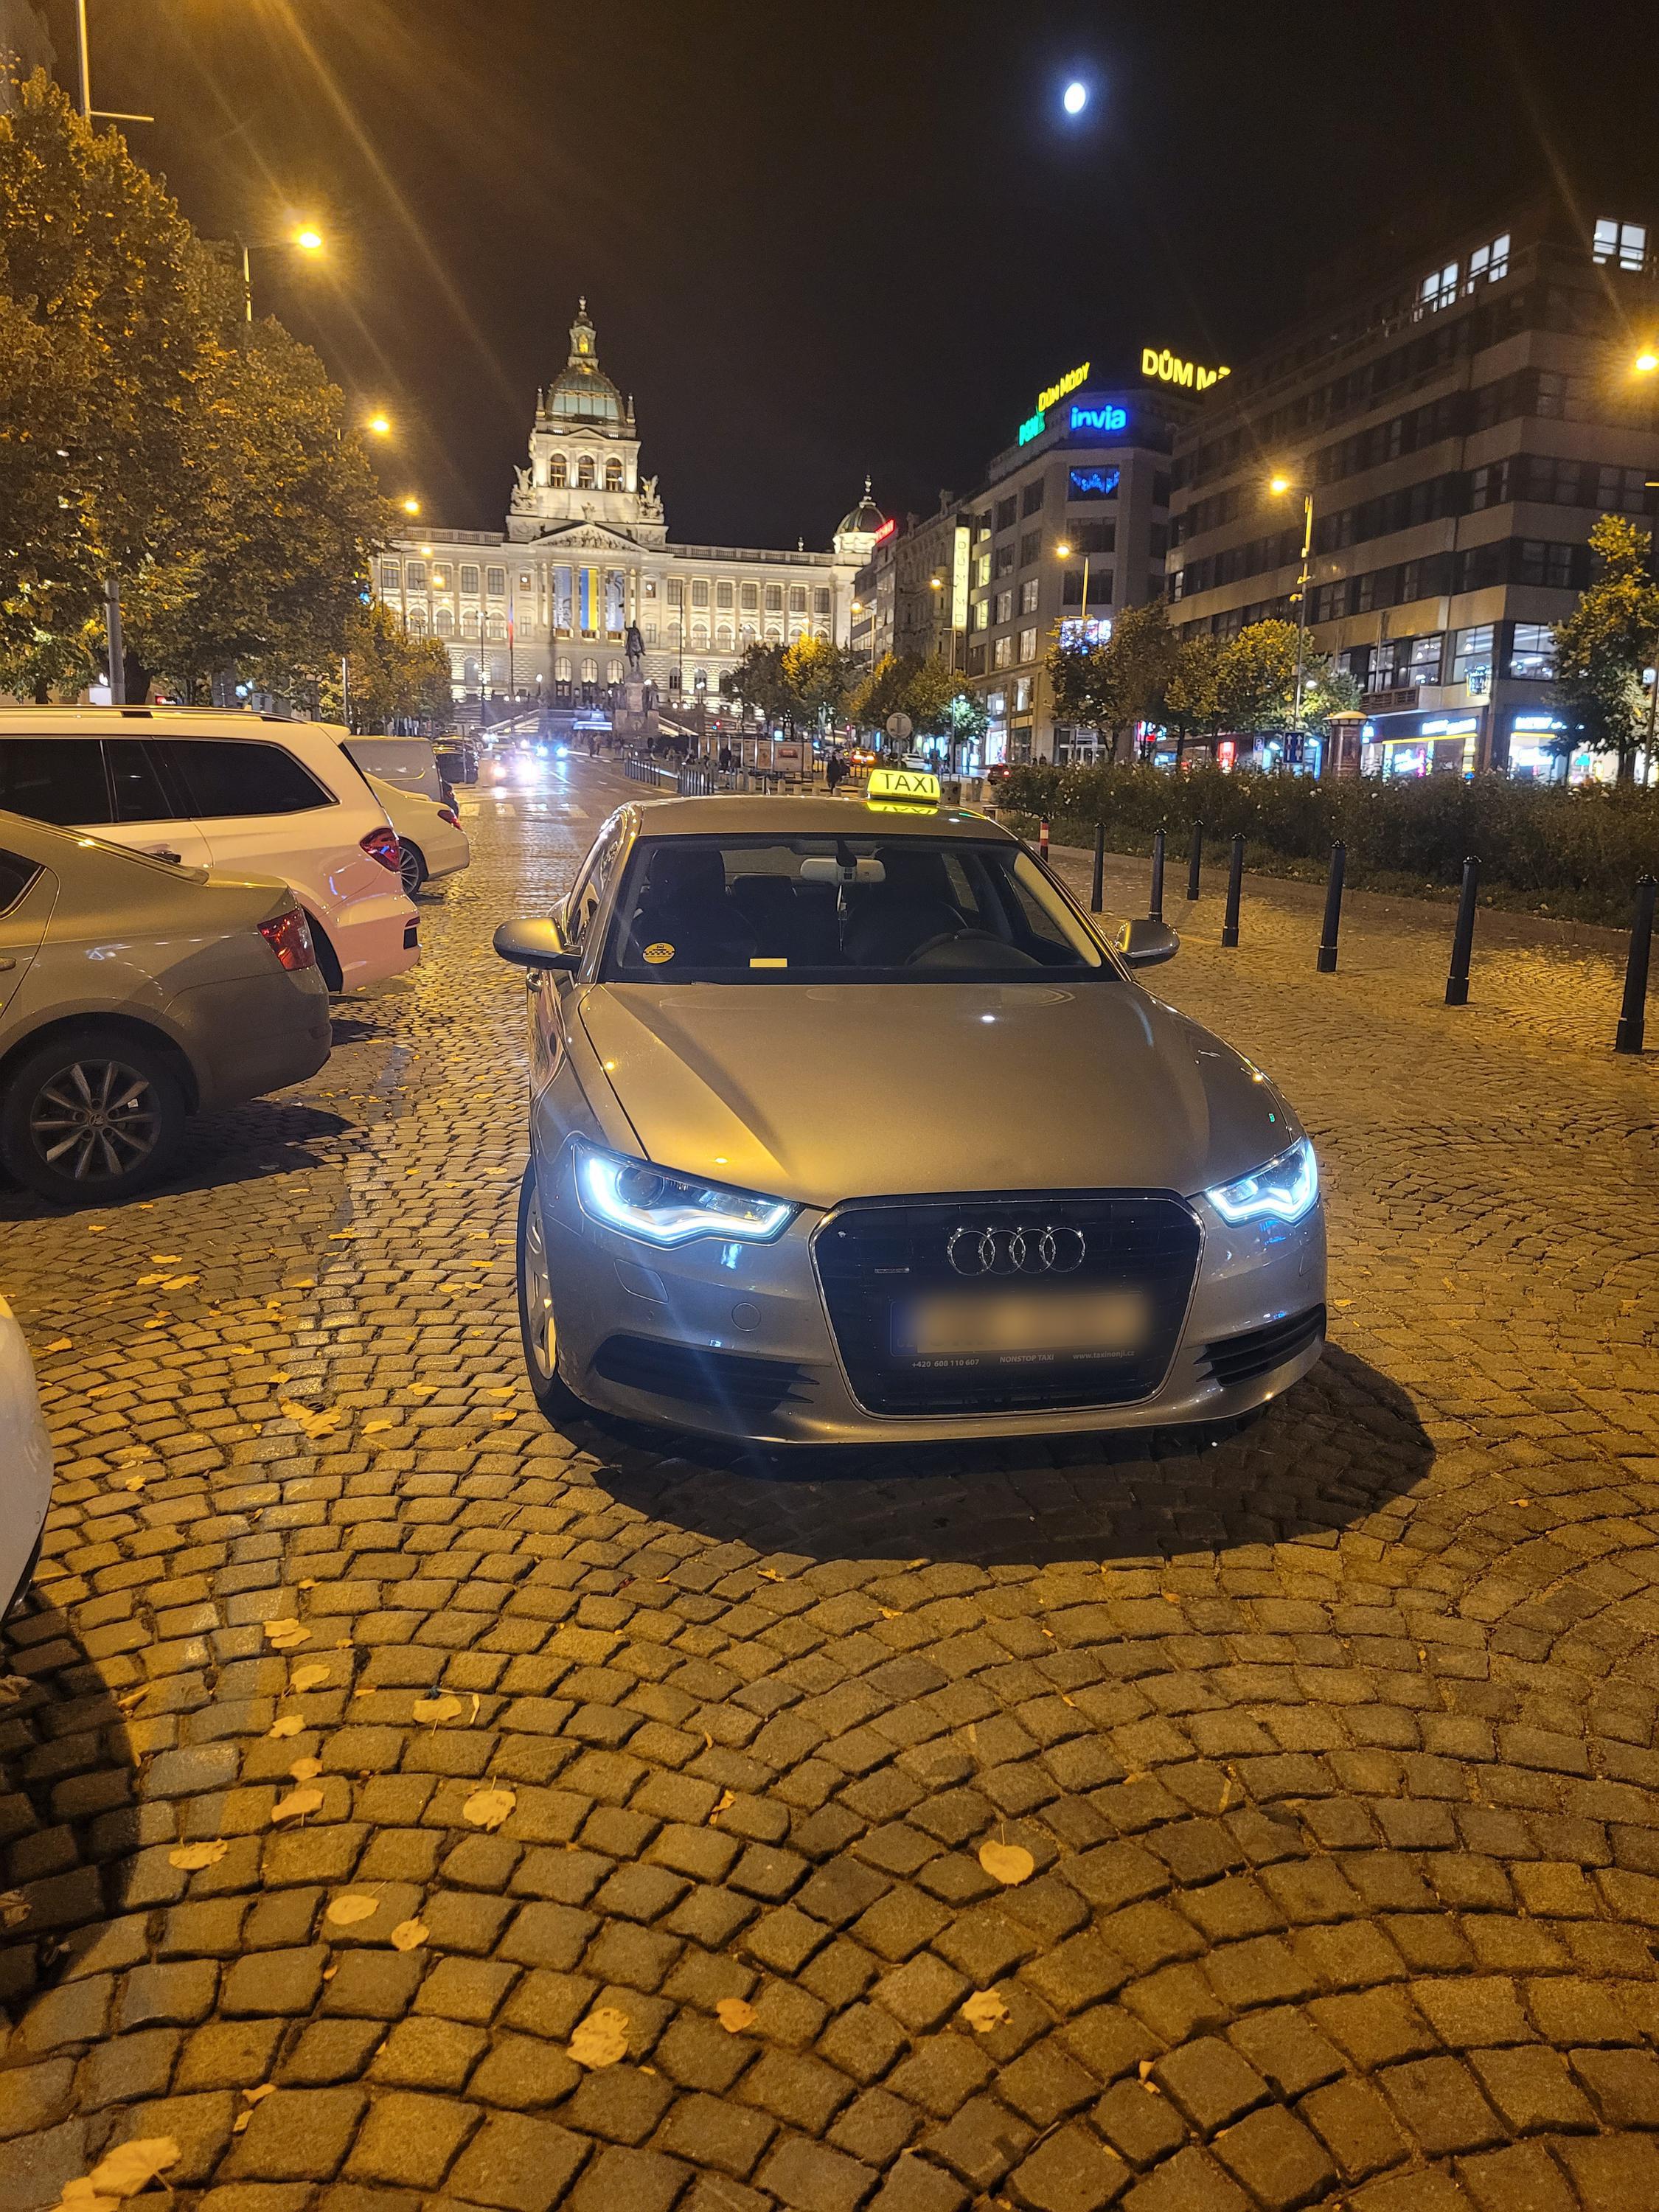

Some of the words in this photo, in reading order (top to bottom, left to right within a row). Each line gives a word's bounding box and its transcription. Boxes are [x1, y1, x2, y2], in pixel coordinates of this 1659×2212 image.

[1071, 405, 1127, 431] invia
[880, 773, 934, 794] TAXI
[999, 1354, 1037, 1363] NONSTOP
[1038, 1354, 1054, 1362] TAXI
